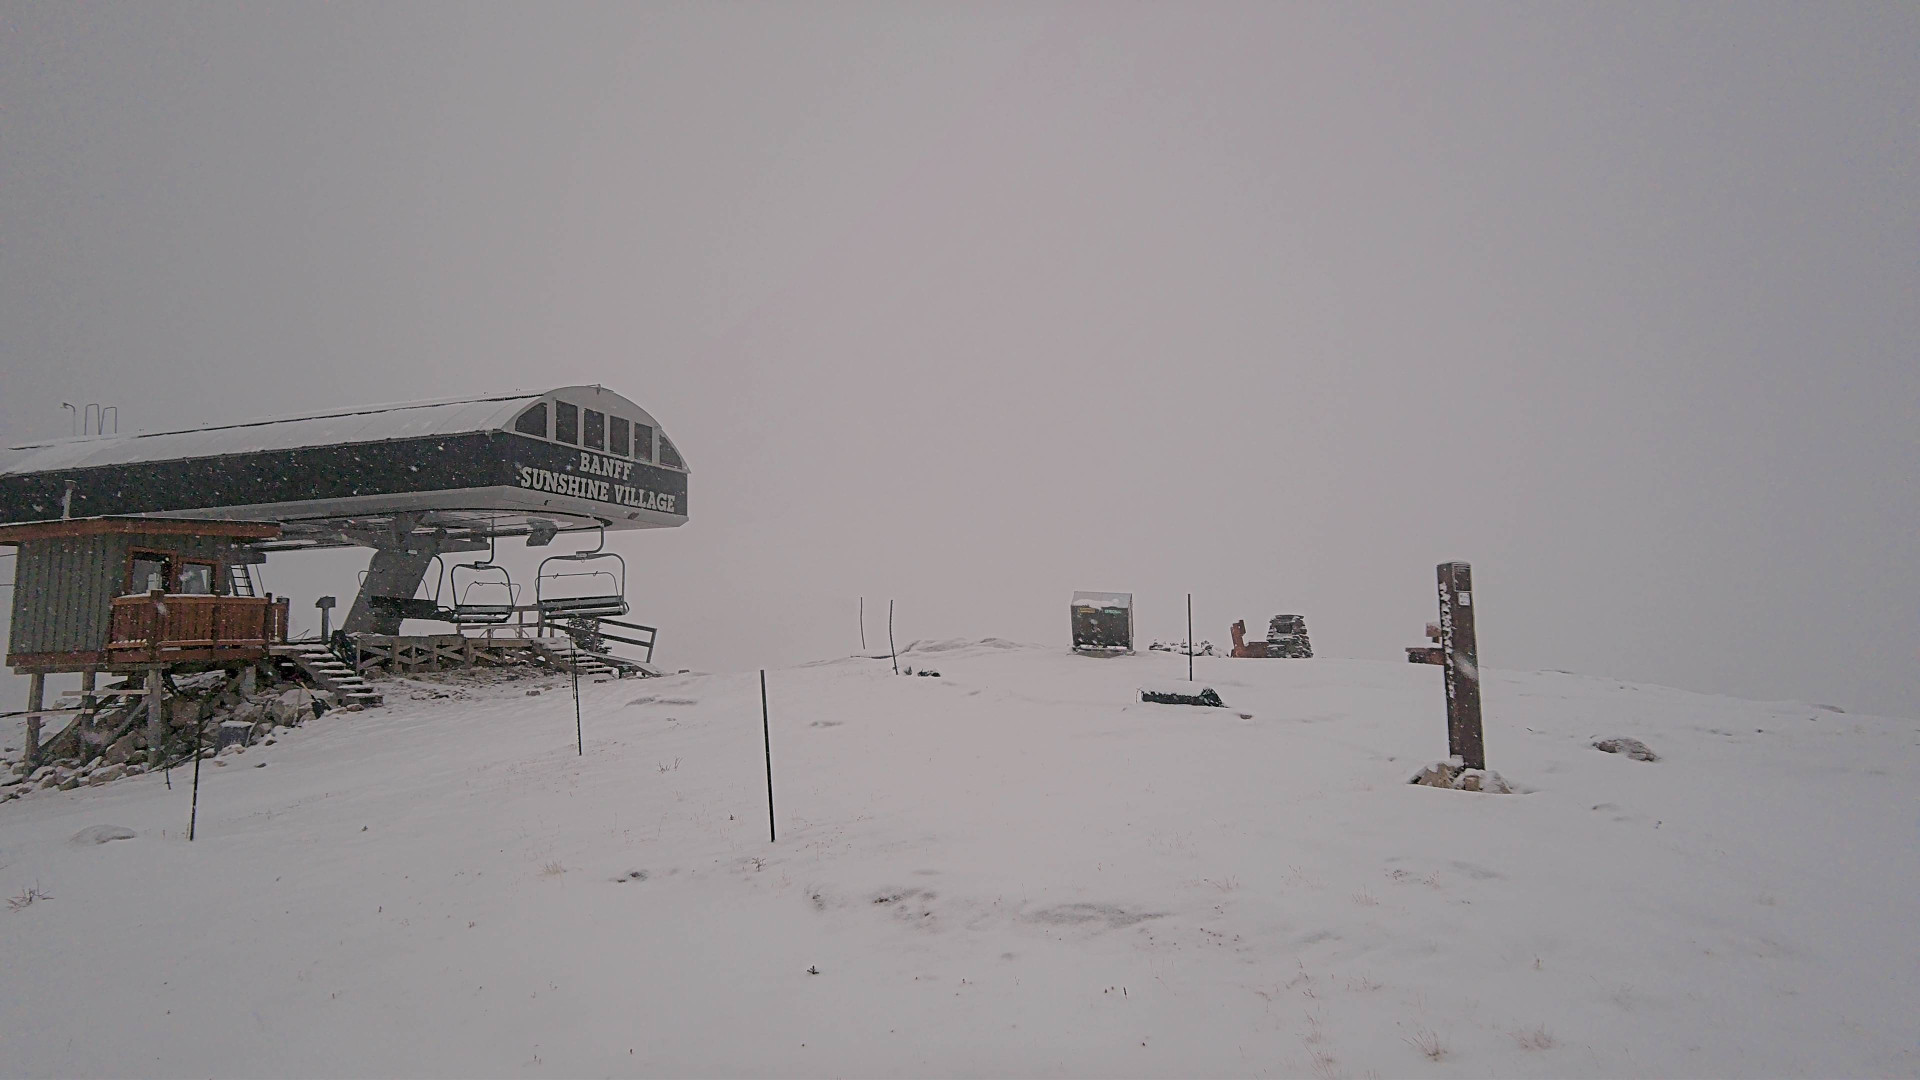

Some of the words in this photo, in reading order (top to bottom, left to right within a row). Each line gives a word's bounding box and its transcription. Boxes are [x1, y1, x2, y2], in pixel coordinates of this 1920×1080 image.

[580, 452, 632, 481] BANFF
[520, 466, 609, 501] SUNSHINE
[614, 484, 675, 512] VILLAGE
